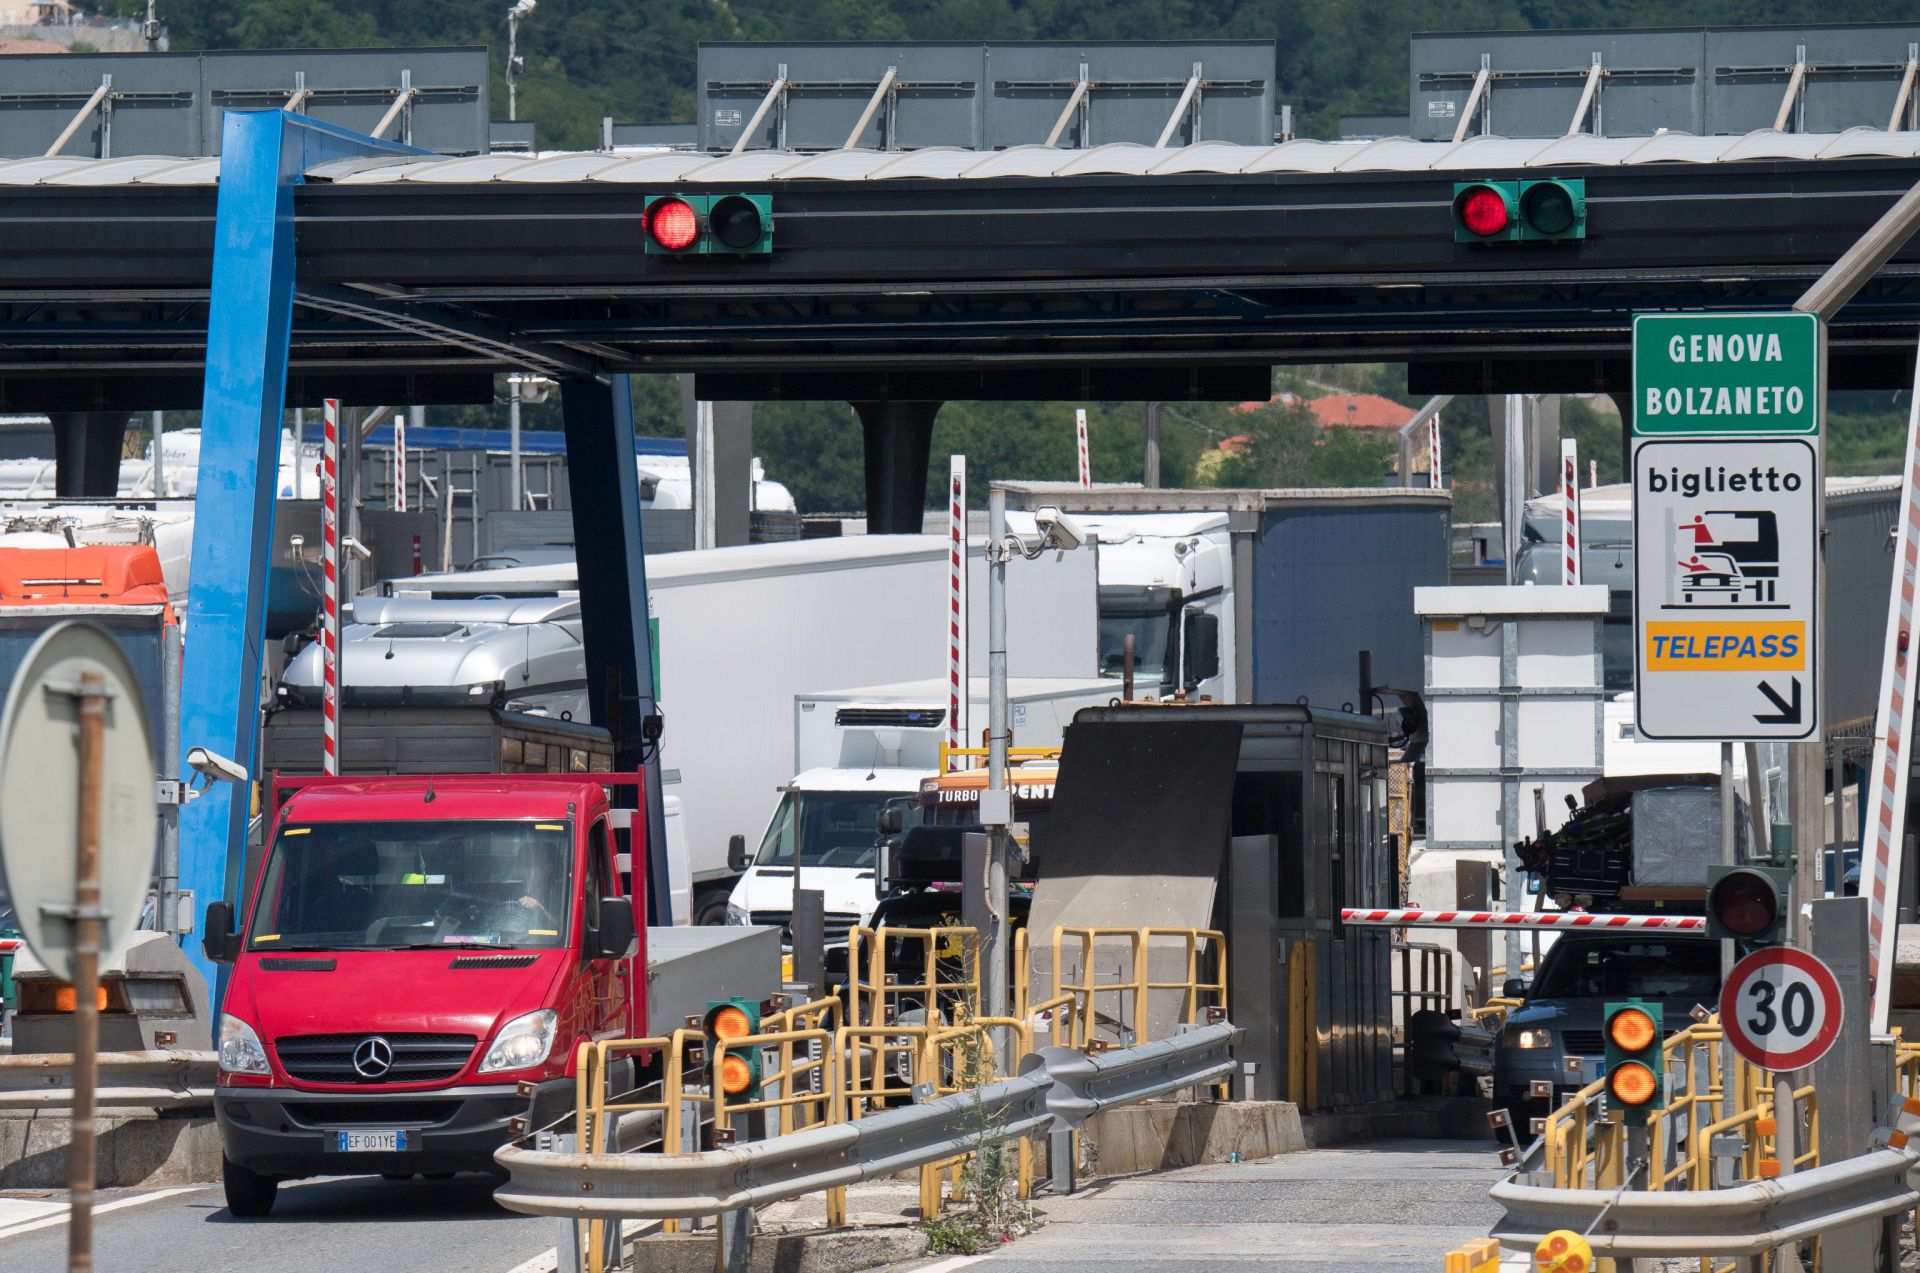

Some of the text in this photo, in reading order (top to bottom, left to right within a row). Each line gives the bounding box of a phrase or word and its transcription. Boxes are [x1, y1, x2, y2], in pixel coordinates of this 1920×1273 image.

[1669, 334, 1782, 363] GENOVA
[1646, 386, 1804, 416] BOLZANETO
[1649, 467, 1801, 498] biglietto
[1652, 635, 1799, 659] TELEPASS
[938, 790, 978, 802] TURBO
[1747, 980, 1815, 1037] 30
